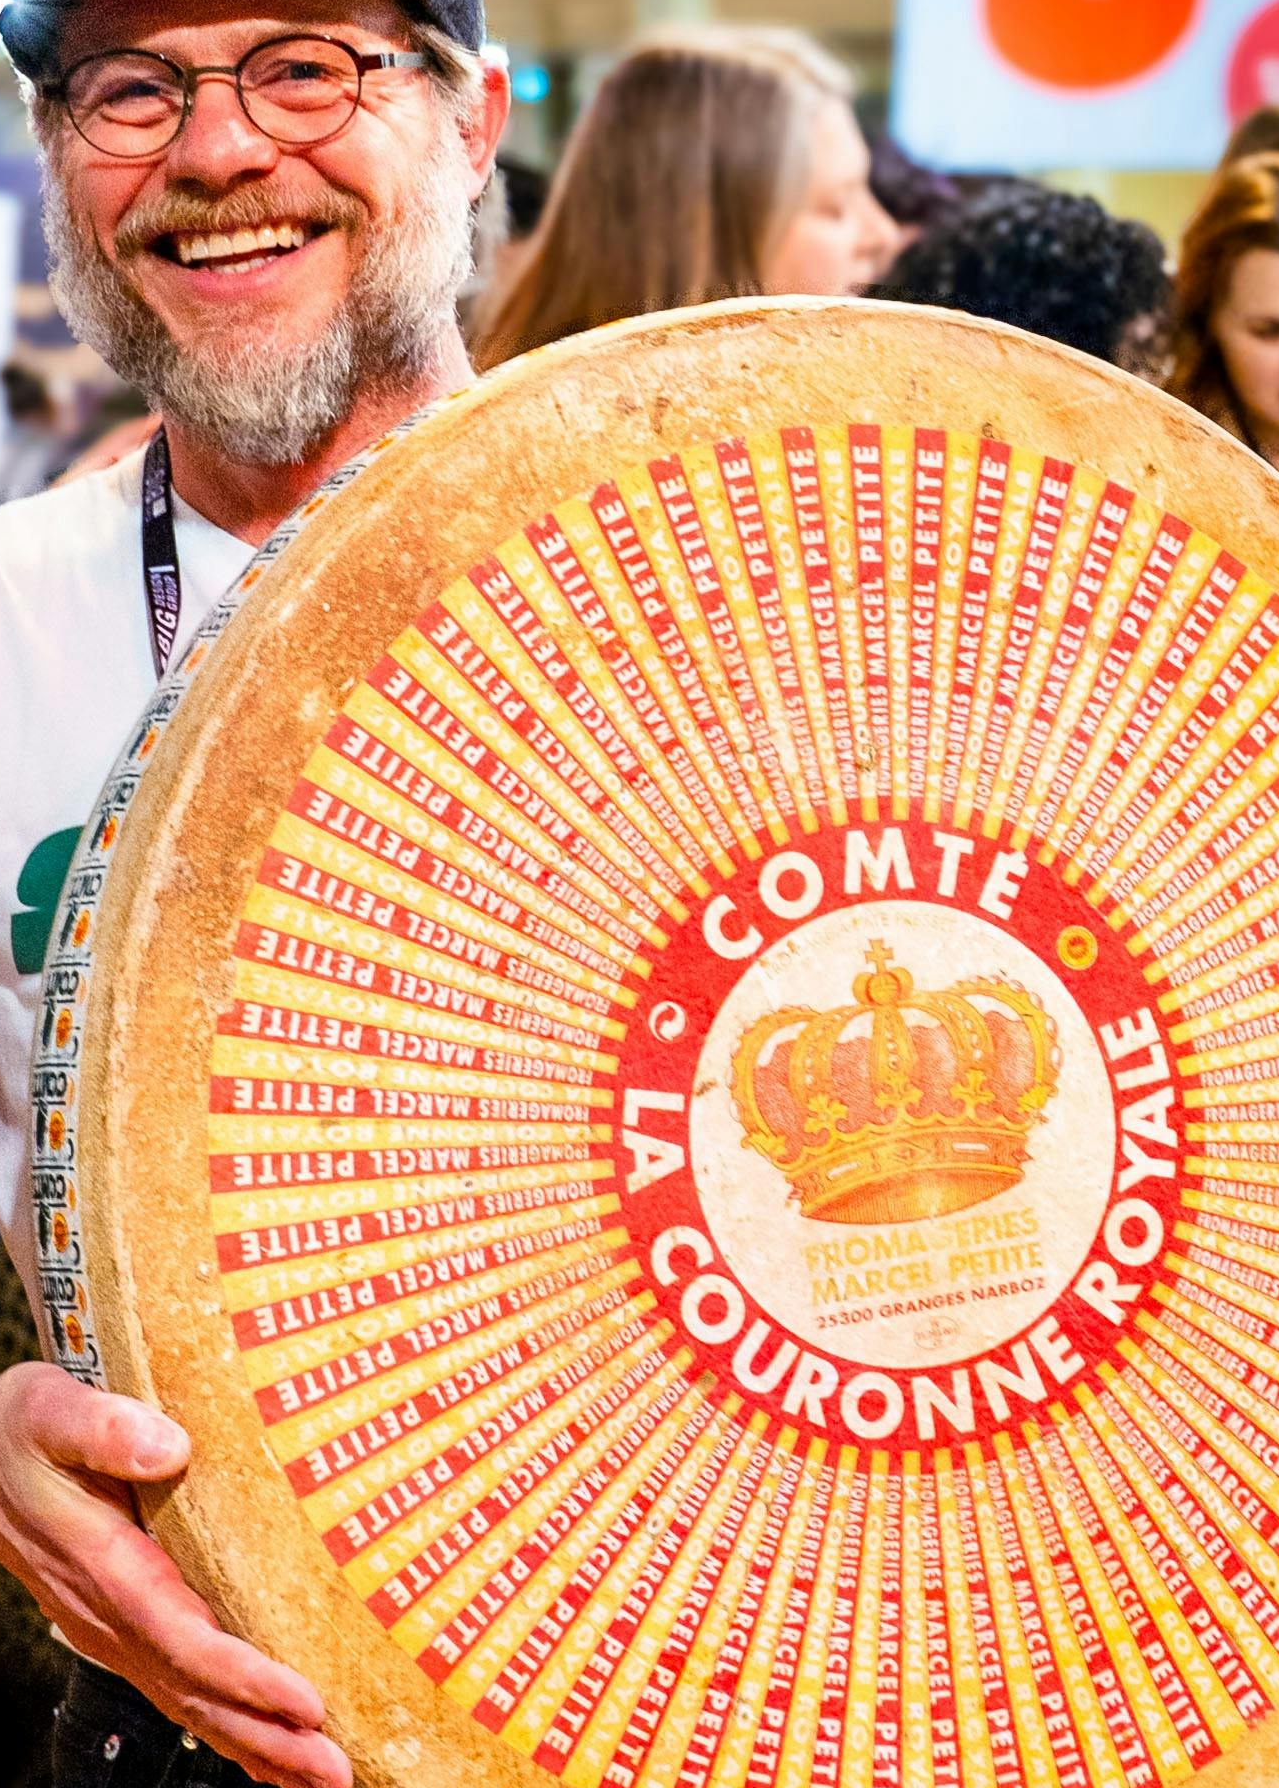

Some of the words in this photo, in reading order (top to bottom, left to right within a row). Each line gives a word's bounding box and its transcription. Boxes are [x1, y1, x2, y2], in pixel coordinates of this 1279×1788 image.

[657, 473, 718, 594] PETITE
[787, 448, 826, 566] PETITE
[149, 572, 166, 609] DESIGN
[165, 574, 179, 612] GROUP
[596, 498, 666, 617] PETITE
[157, 610, 177, 656] BIG
[429, 614, 526, 722] PETITE
[481, 569, 569, 682] PETITE
[655, 623, 713, 721] MARCEL
[704, 602, 754, 702] MARCEL
[808, 579, 841, 680] MARCEL
[1114, 670, 1174, 760] MARCEL
[1164, 566, 1238, 670] PETITE
[382, 667, 486, 767] PETITE
[522, 718, 603, 806] MARCEL
[563, 681, 637, 774] MARCEL
[1149, 704, 1215, 789] MARCEL
[340, 724, 451, 817] PETITE
[484, 760, 572, 842] MARCEL
[1181, 742, 1252, 822] MARCEL
[305, 787, 421, 871] PETITE
[451, 807, 544, 881] MARCEL
[276, 857, 395, 928] PETITE
[424, 857, 520, 924] MARCEL
[702, 827, 1028, 960] COMTÉ
[254, 927, 376, 987] PETITE
[401, 912, 500, 970] MARCEL
[240, 1003, 362, 1049] PETITE
[384, 969, 485, 1017] MARCEL
[374, 1029, 475, 1066] MARCEL
[233, 1079, 354, 1113] PETITE
[369, 1090, 469, 1117] MARCEL
[623, 1086, 686, 1193] LA
[233, 1151, 354, 1186] PETITE
[369, 1147, 469, 1175] MARCEL
[1073, 1007, 1179, 1327] ROYALE
[239, 1215, 361, 1264] PETITE
[374, 1198, 475, 1237] MARCEL
[254, 1278, 375, 1339] PETITE
[385, 1248, 486, 1298] MARCEL
[811, 1259, 934, 1307] MARCEL
[947, 1242, 1043, 1283] PETITE
[815, 1308, 874, 1329] 25300
[878, 1290, 966, 1318] GRANGES
[971, 1276, 1047, 1301] NARBOZ
[650, 1225, 1085, 1440] COURONNE
[487, 1427, 576, 1513] MARCEL
[526, 1465, 609, 1557] MARCEL
[382, 1505, 489, 1611] PETITE
[567, 1498, 644, 1596] MARCEL
[1165, 1481, 1235, 1570] MARCEL
[431, 1553, 531, 1666] PETITE
[612, 1527, 682, 1630] MARCEL
[662, 1553, 722, 1657] MARCEL
[713, 1573, 765, 1678] MARCEL
[1130, 1512, 1196, 1606] MARCEL
[1187, 1606, 1267, 1716] PETITE
[485, 1595, 576, 1714] PETITE
[766, 1588, 809, 1693] MARCEL
[820, 1597, 854, 1703] MARCEL
[875, 1602, 897, 1705] MARCEL
[925, 1599, 952, 1703] MARCEL
[969, 1591, 1004, 1695] MARCEL
[1011, 1577, 1055, 1682] MARCEL
[1053, 1559, 1105, 1662] MARCEL
[1091, 1667, 1156, 1788] PETITE
[1092, 1537, 1152, 1636] MARCEL
[1139, 1639, 1213, 1756] PETITE
[543, 1631, 625, 1756] PETITE
